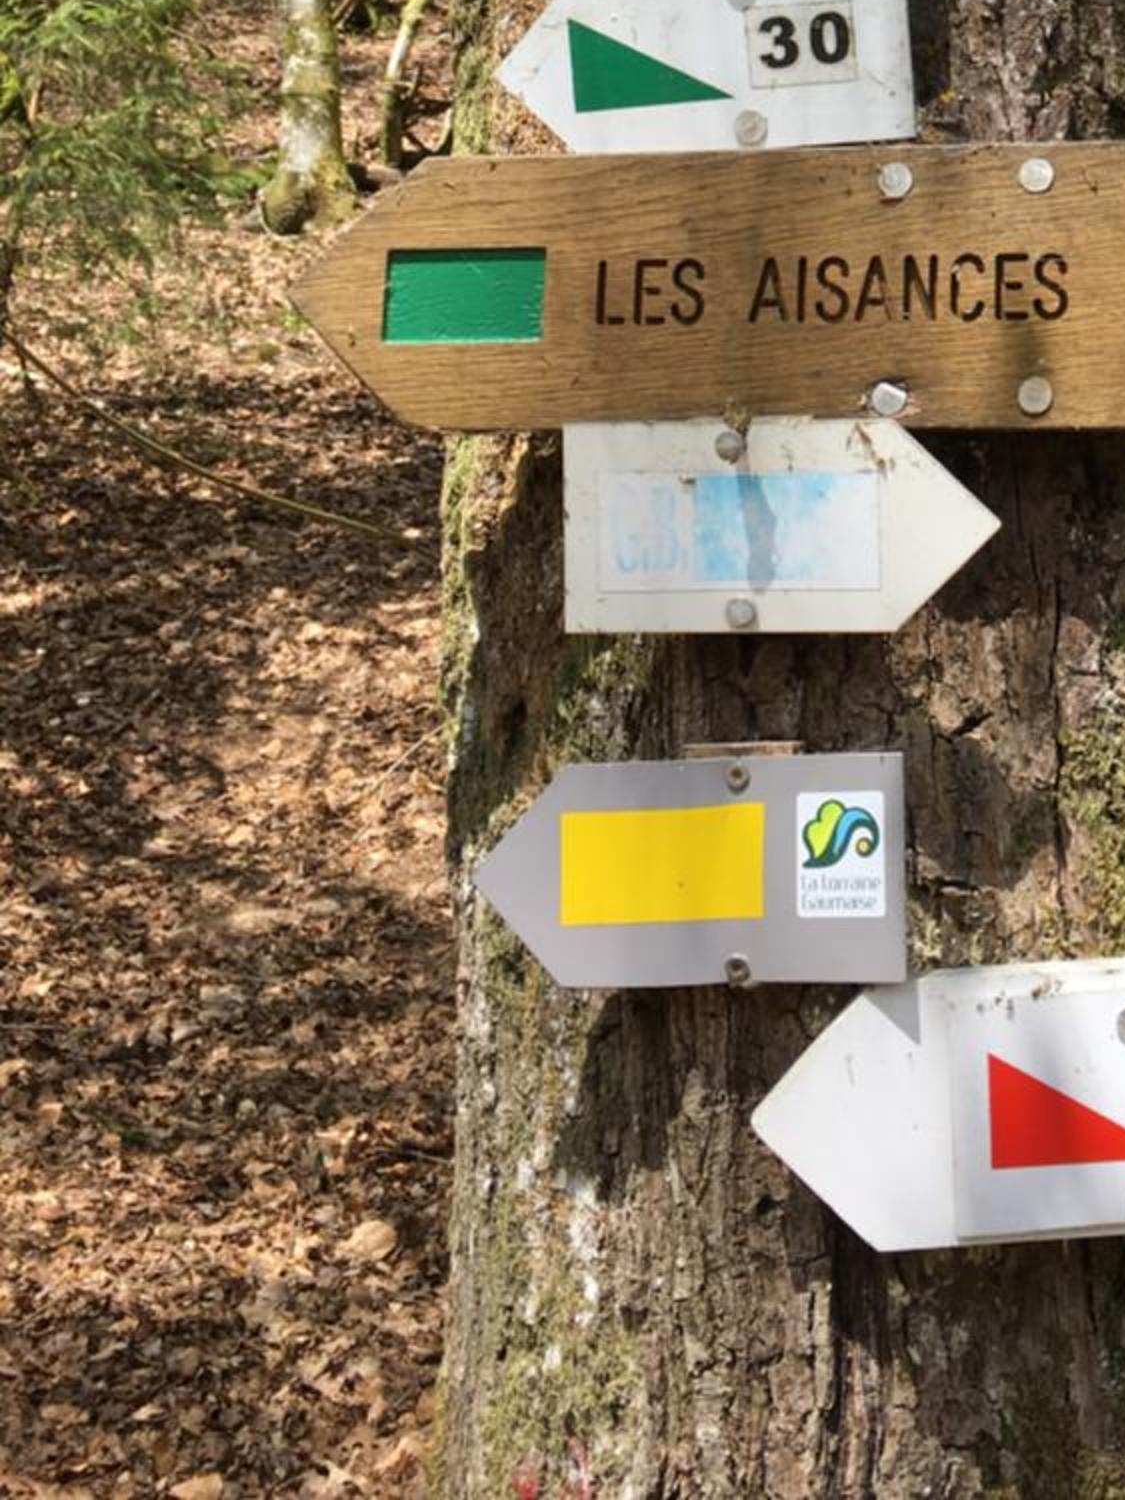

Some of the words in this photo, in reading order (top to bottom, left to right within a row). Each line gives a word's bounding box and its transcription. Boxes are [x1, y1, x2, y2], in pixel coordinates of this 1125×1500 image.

[758, 8, 852, 70] 30
[593, 257, 706, 327] LES
[747, 251, 1070, 325] AISANCES
